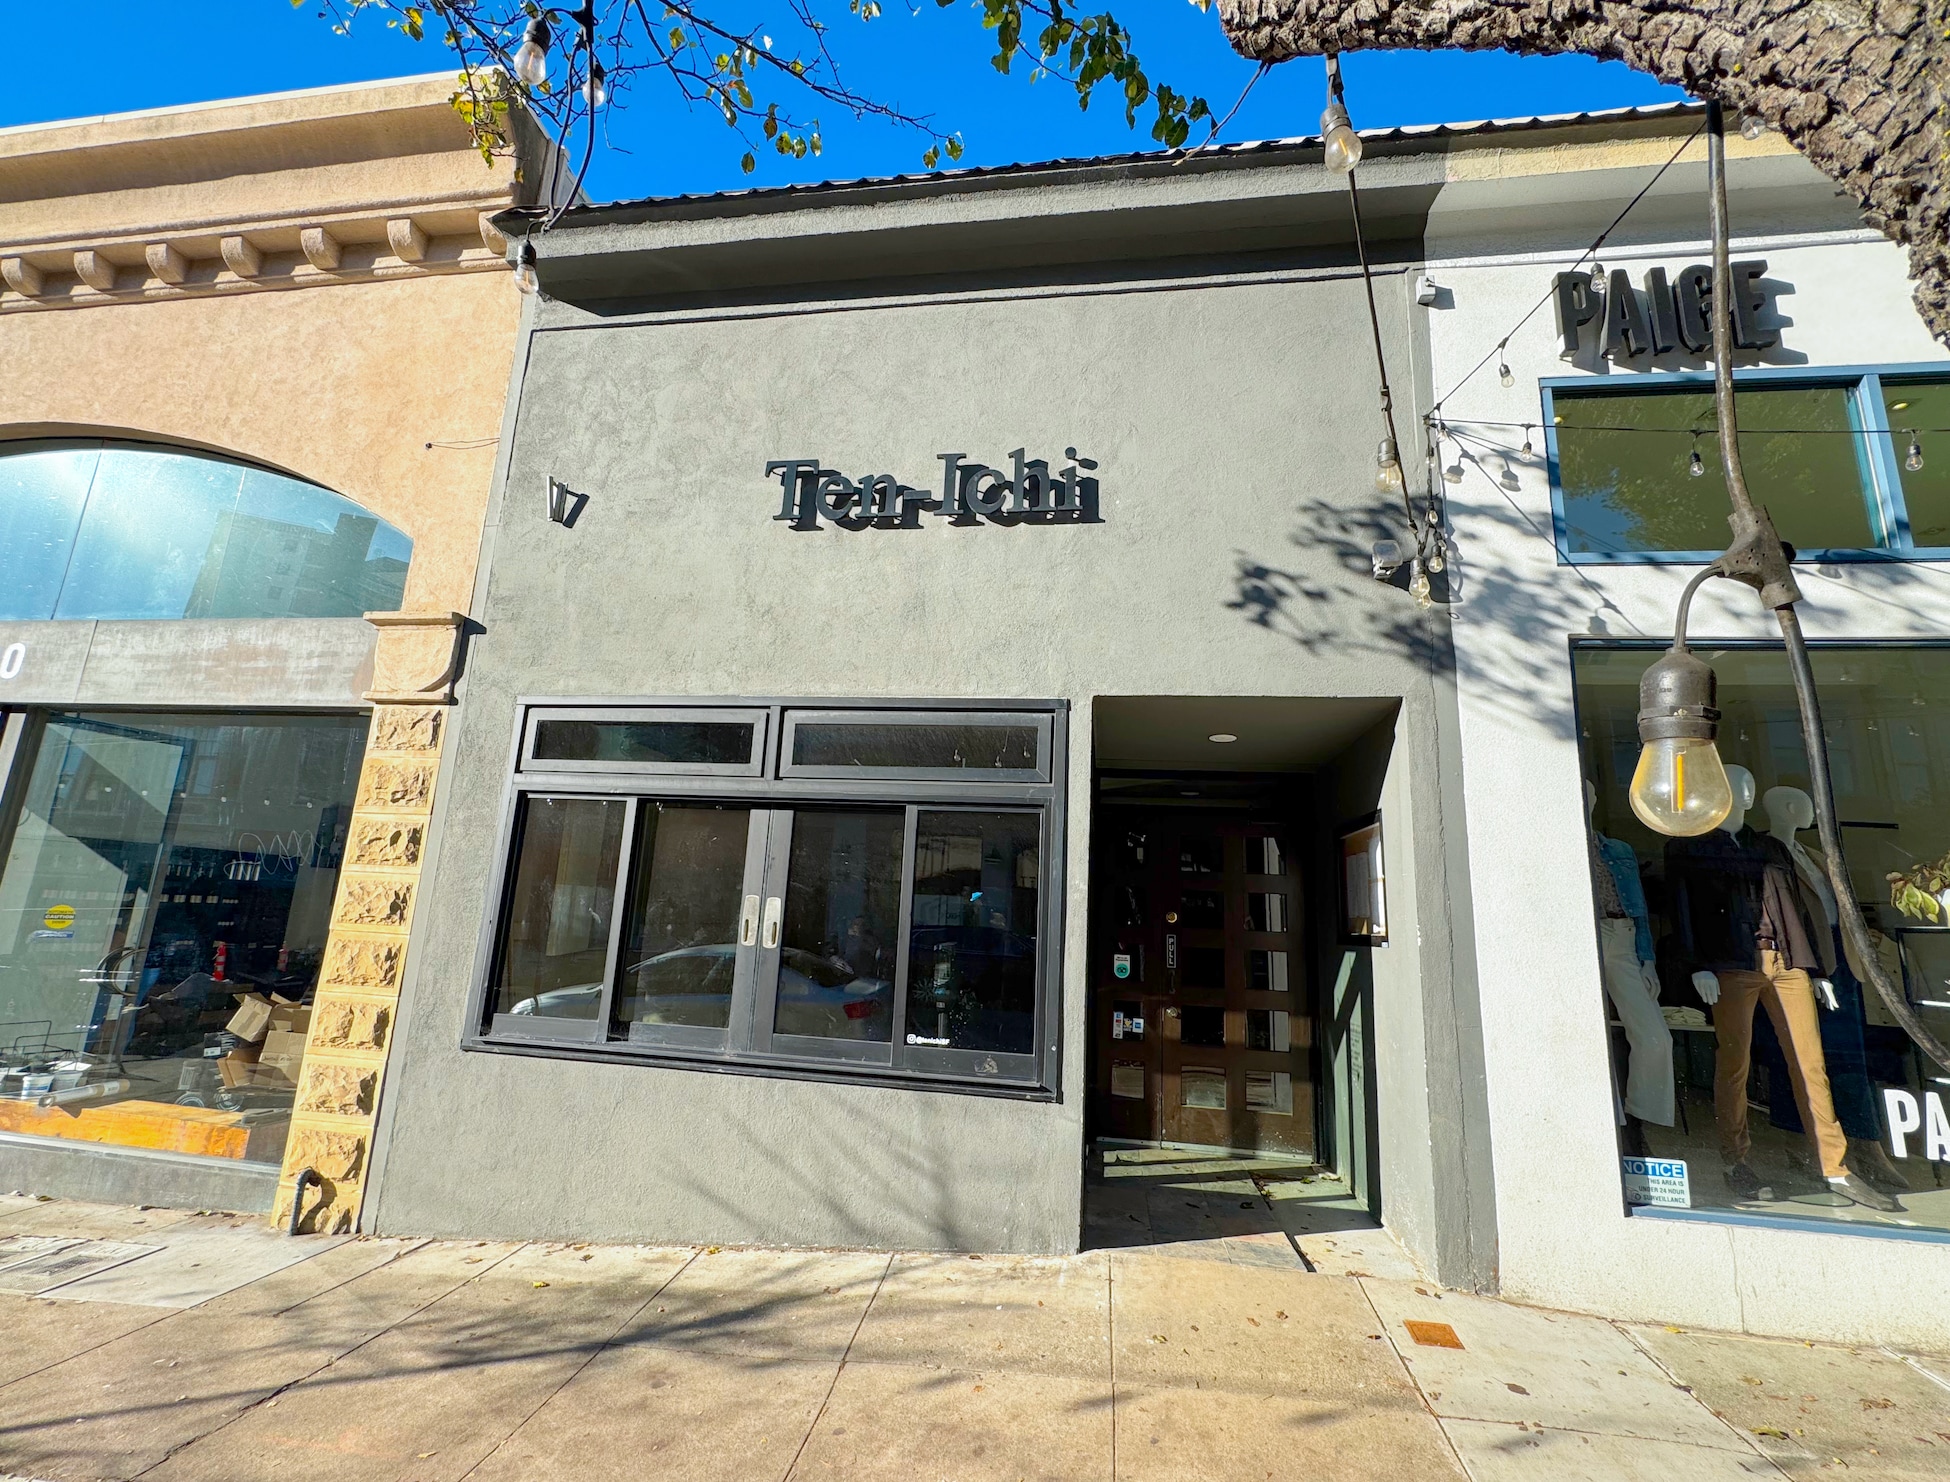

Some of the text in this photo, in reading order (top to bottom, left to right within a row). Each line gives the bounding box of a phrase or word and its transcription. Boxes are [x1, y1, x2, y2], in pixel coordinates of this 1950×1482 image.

[1551, 260, 1779, 358] PAIGE
[765, 446, 1084, 521] Ten-Ichi
[1623, 1160, 1684, 1178] NOTICE
[1643, 1194, 1686, 1204] SURVEILLANCE
